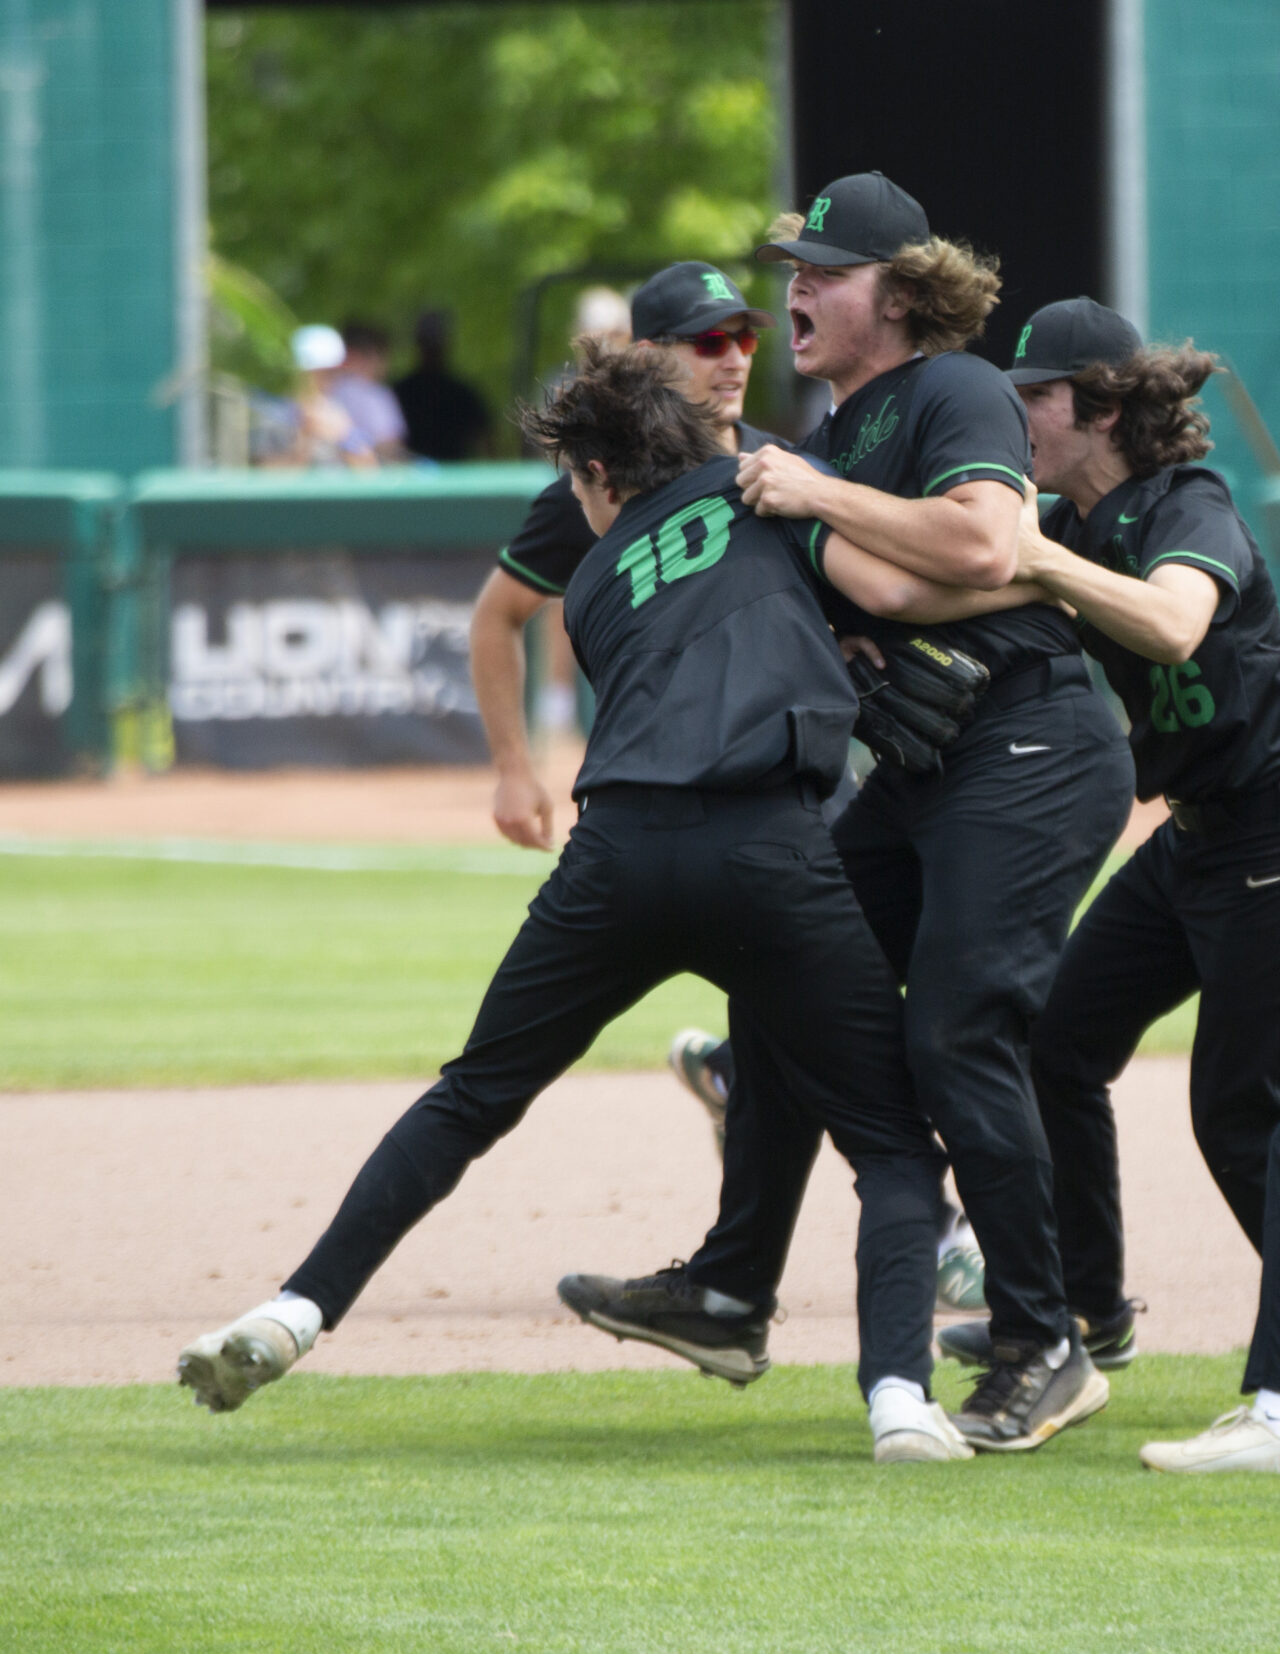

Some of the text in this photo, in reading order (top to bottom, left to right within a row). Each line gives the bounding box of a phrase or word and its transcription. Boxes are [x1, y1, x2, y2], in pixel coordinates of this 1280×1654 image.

[805, 197, 831, 233] R
[701, 272, 735, 301] R
[615, 495, 736, 609] 10
[909, 637, 953, 667] A2000
[1150, 659, 1216, 733] 26
